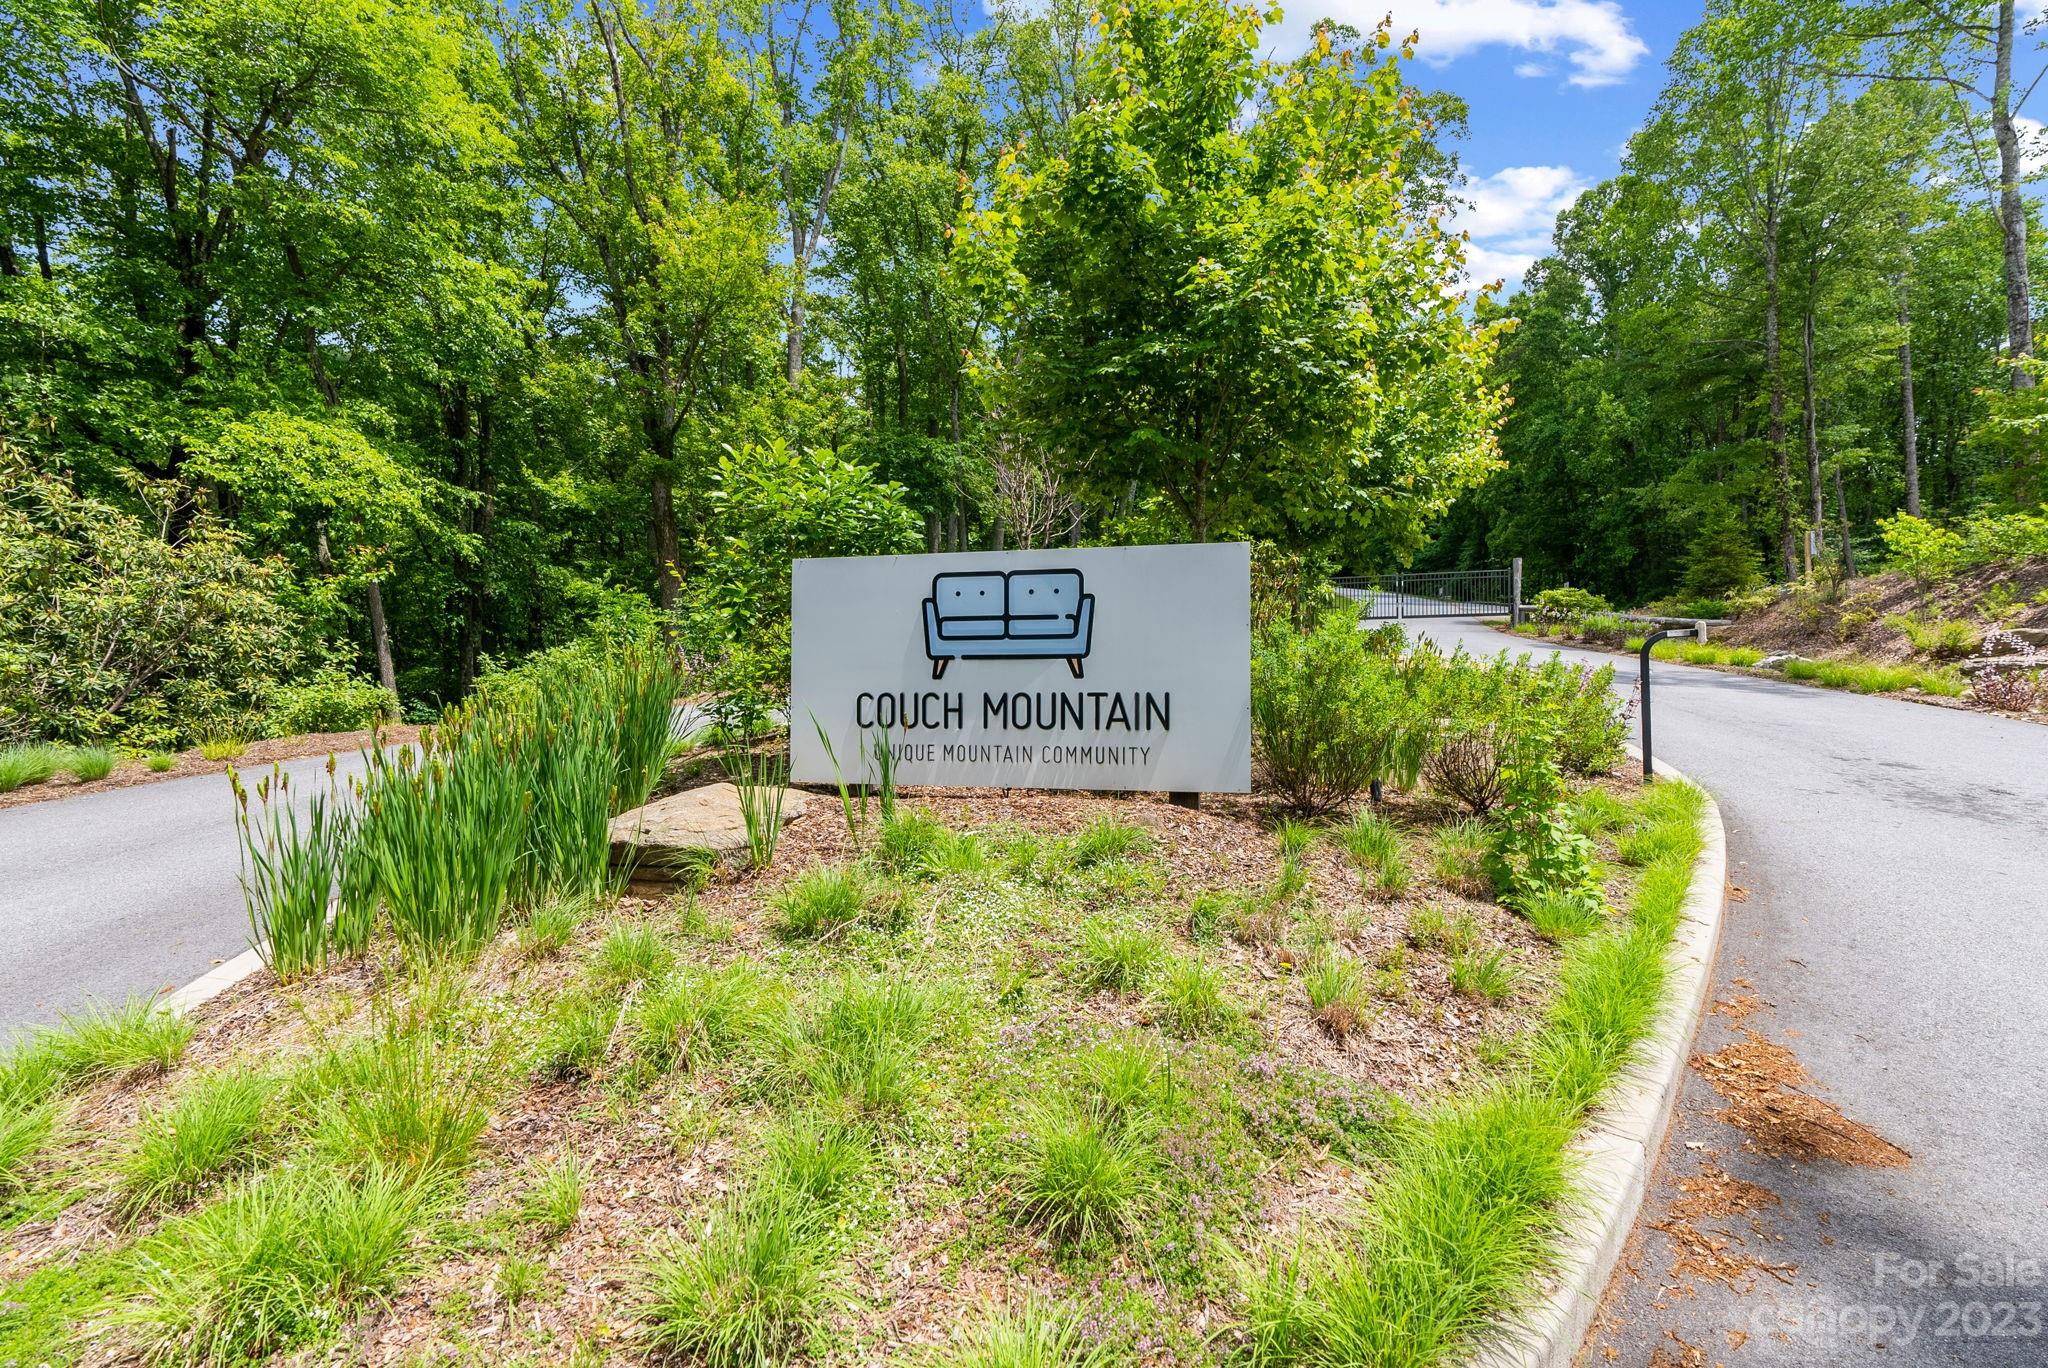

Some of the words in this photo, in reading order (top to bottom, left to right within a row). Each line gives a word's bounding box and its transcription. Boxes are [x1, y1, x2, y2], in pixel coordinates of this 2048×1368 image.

[857, 692, 963, 730] COUCH
[983, 692, 1171, 731] MOUNTAIN
[943, 745, 1033, 763] MOUNTAIN
[1042, 746, 1151, 765] COMMUNITY
